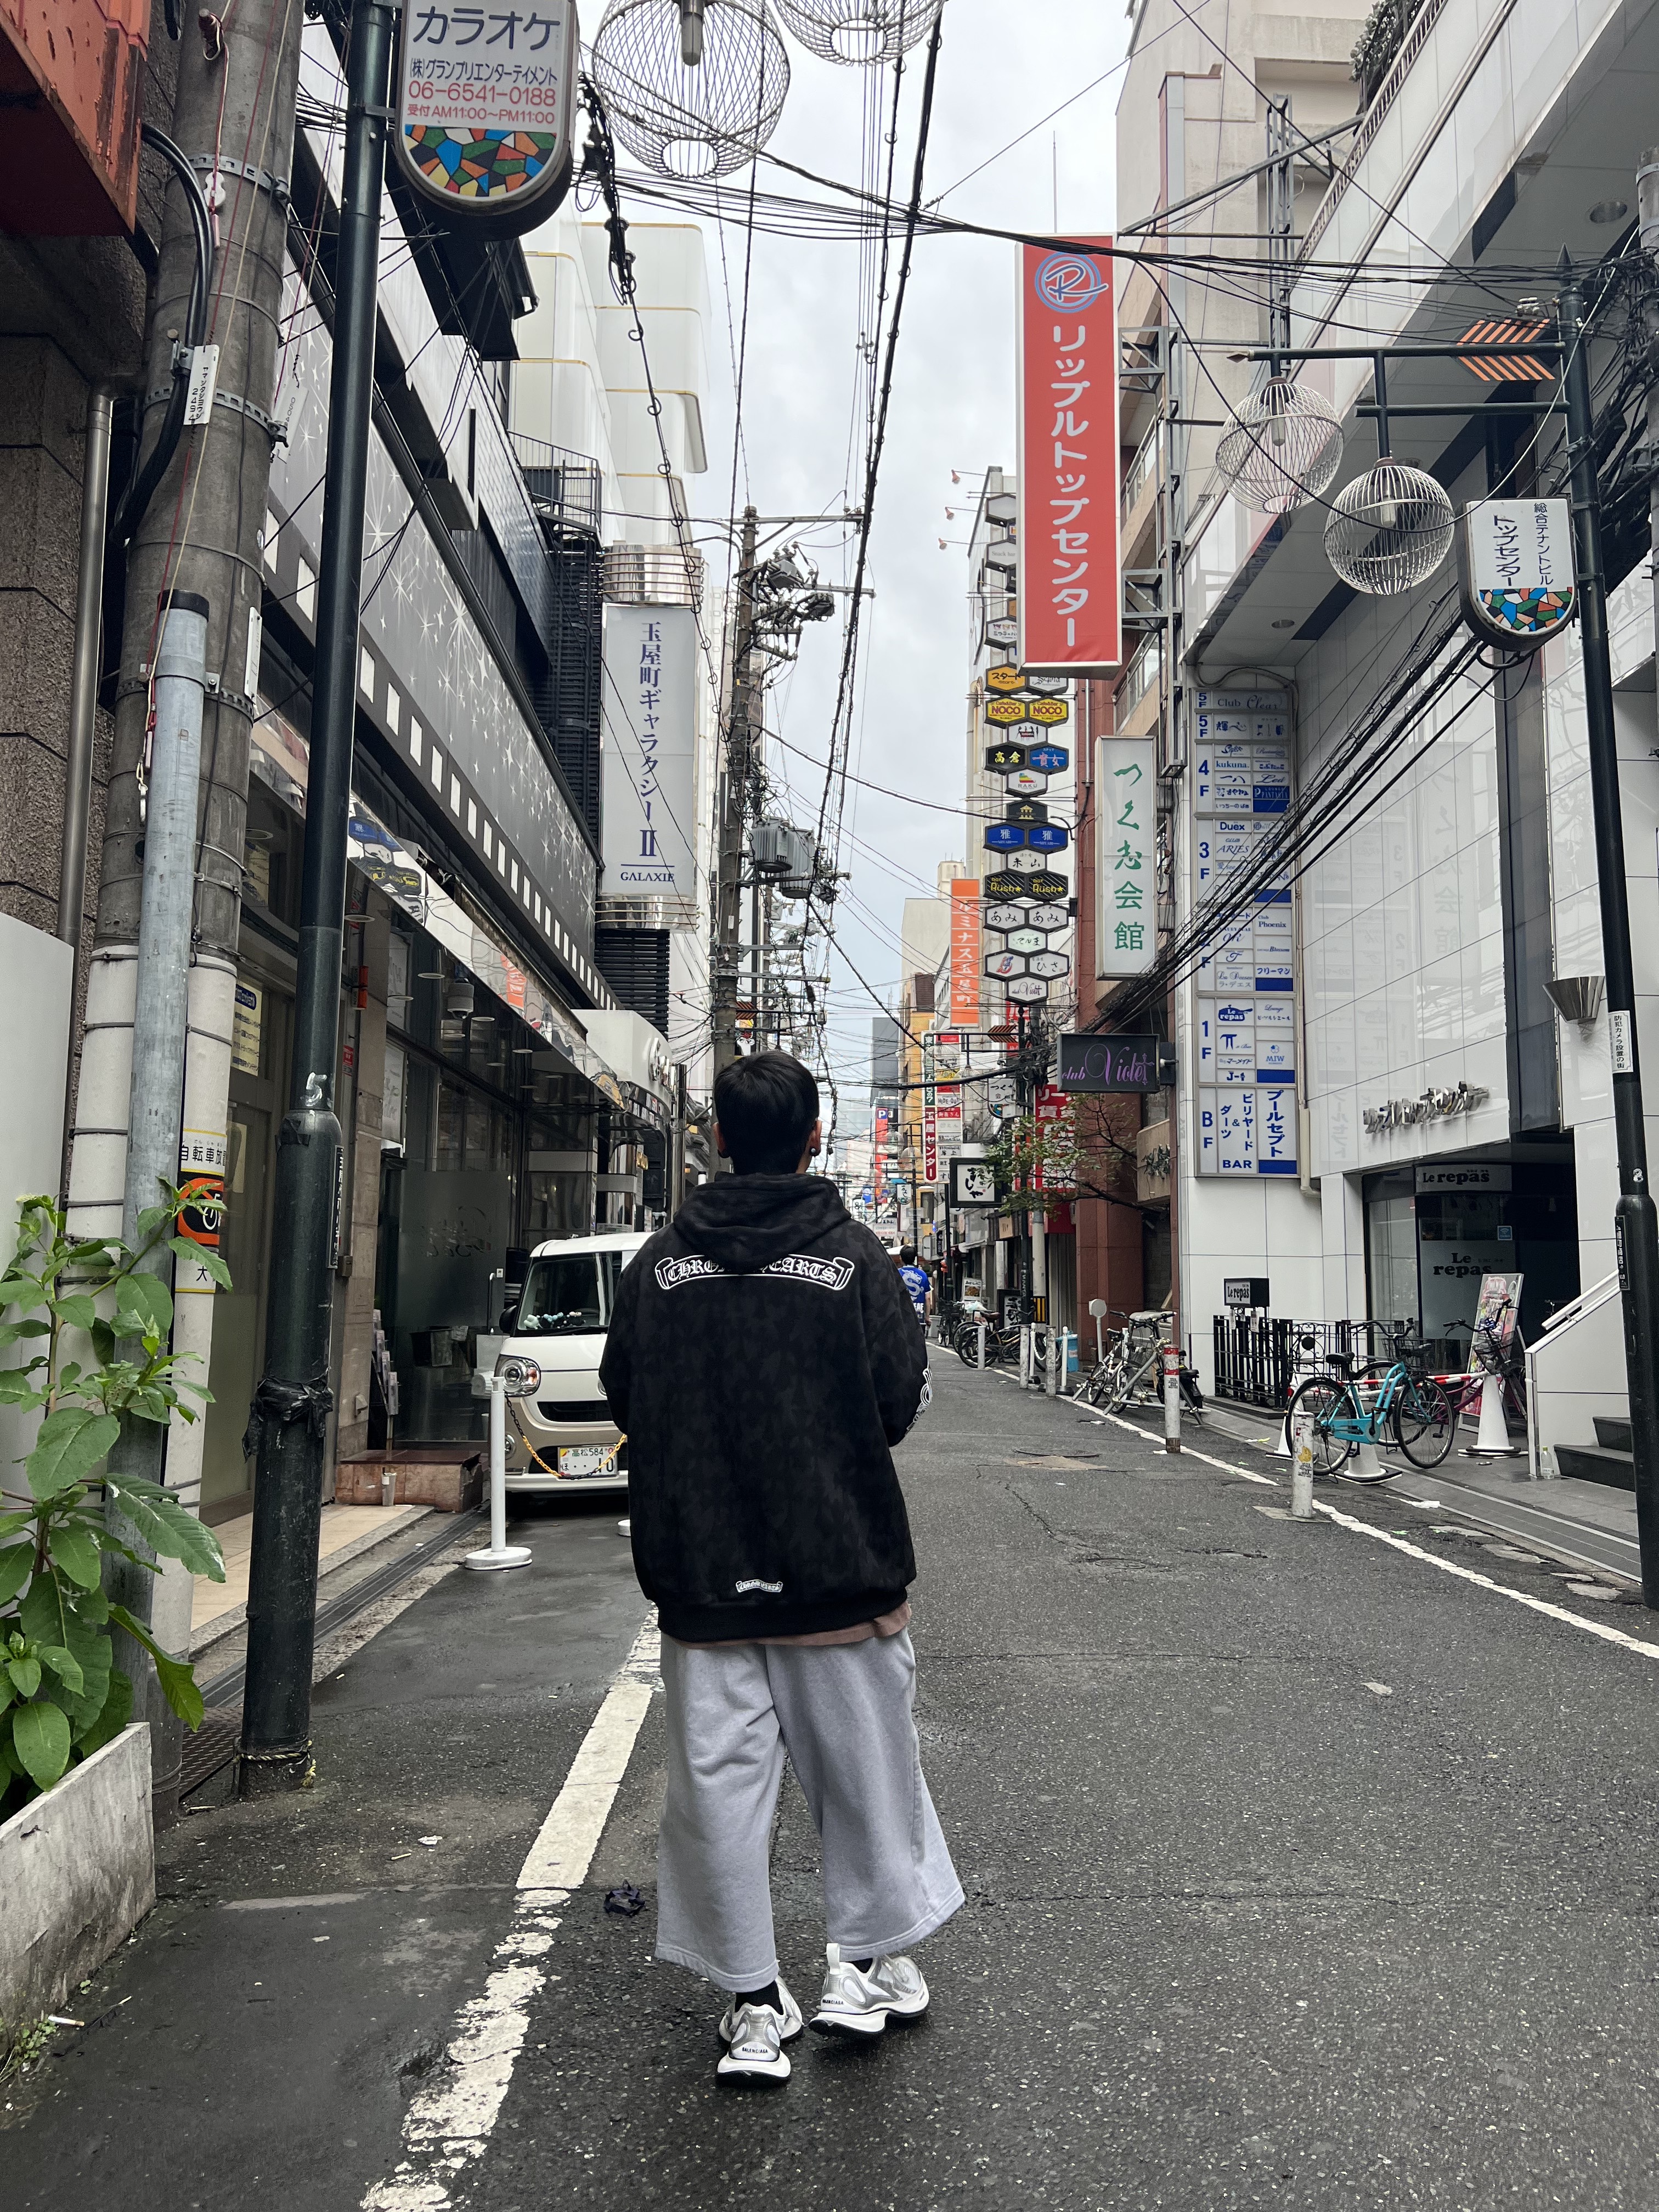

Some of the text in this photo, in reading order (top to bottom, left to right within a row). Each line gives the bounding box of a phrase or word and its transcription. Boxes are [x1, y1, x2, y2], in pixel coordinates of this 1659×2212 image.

[413, 5, 561, 50] カラオケ
[408, 80, 556, 107] 06-6541-0188
[1049, 324, 1090, 647] リップルトップセンター
[1493, 514, 1521, 586] トップセンター
[1217, 698, 1241, 707] Club
[991, 706, 1021, 715] NOCO
[1032, 706, 1063, 715] NOCO
[1220, 821, 1245, 831] Duex
[1000, 828, 1011, 840] 雅
[1042, 830, 1053, 841] 雅
[1216, 845, 1250, 855] ARIES
[620, 871, 675, 882] GALAXIE
[1613, 1015, 1625, 1069] 防犯カメラ設置の街
[1062, 1066, 1086, 1081] club
[303, 1071, 329, 1107] 5
[1220, 1105, 1232, 1139] ダーツ
[1232, 1119, 1240, 1127] &
[1242, 1093, 1254, 1151] ビリヤード
[1266, 1090, 1285, 1157] プールセプト
[925, 1110, 936, 1178] 玉屋センター
[1223, 1160, 1252, 1169] BAR
[1423, 1171, 1491, 1186] Le repas
[1451, 1252, 1472, 1264] Le
[1432, 1264, 1493, 1279] repas
[1227, 1286, 1250, 1302] Le repas
[589, 1447, 604, 1457] 584
